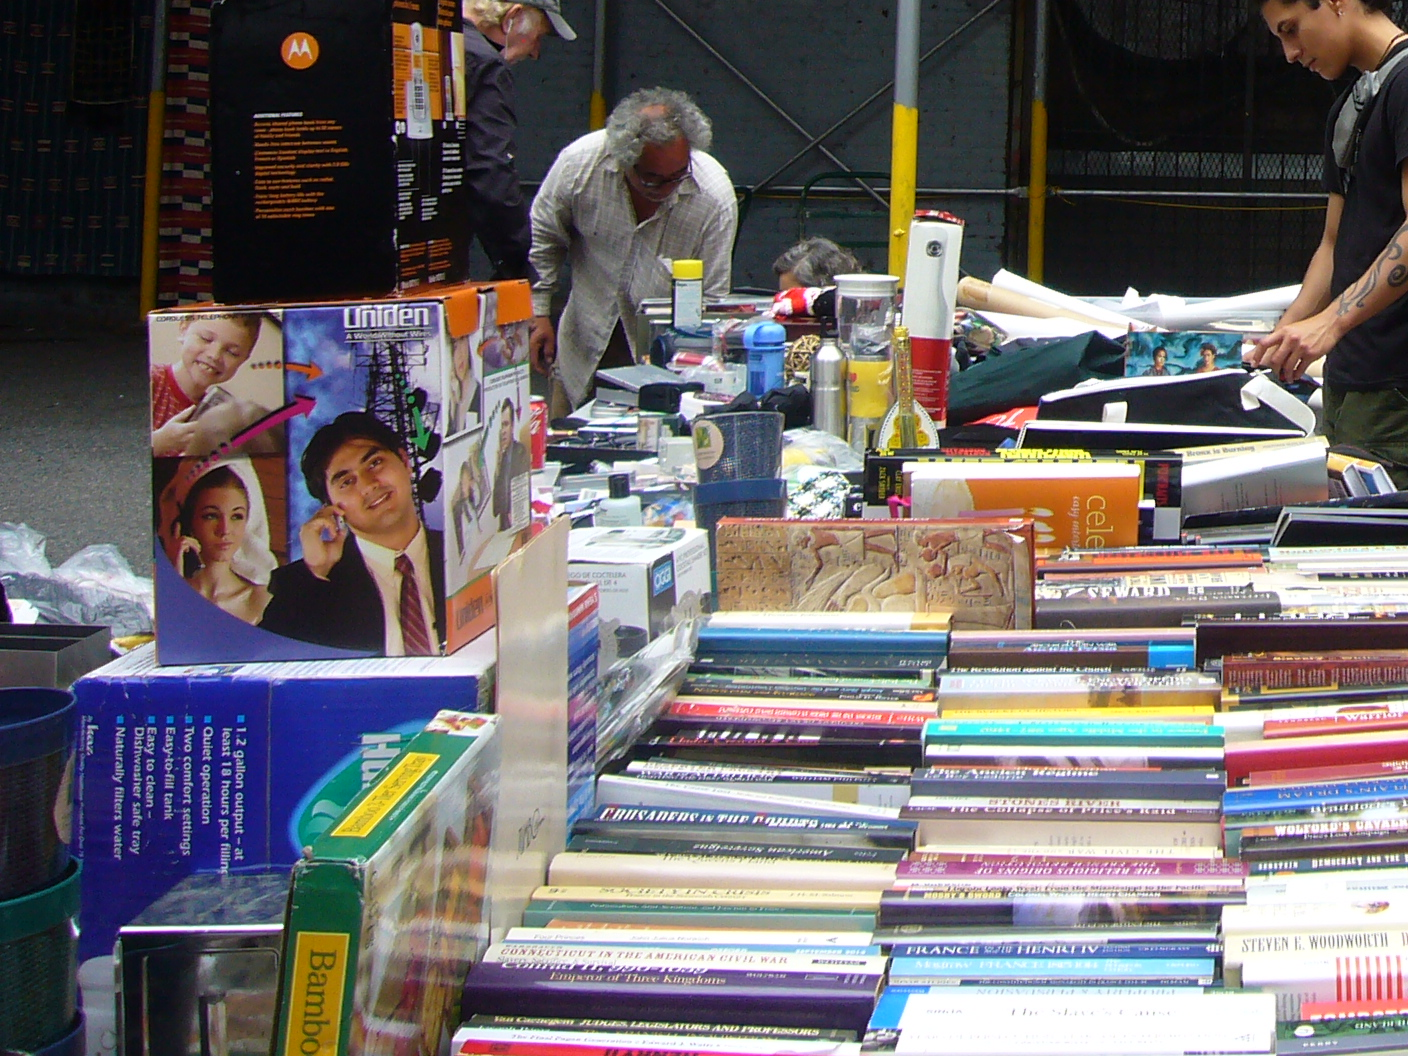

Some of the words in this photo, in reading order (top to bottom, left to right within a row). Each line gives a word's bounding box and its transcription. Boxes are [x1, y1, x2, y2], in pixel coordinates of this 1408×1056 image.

[344, 305, 429, 328] Uniden
[1222, 445, 1255, 455] Burning
[592, 571, 627, 579] COCTELERA
[654, 566, 672, 588] OGGI
[1087, 586, 1171, 599] SEWARD
[1345, 711, 1401, 723] Warrior
[144, 727, 157, 755] Easy
[184, 726, 195, 752] Two
[202, 726, 213, 761] Quiet
[221, 727, 233, 757] least
[236, 726, 247, 746] 1.2
[112, 727, 126, 783] Naturally
[133, 727, 145, 799] Dishwasher
[162, 727, 176, 789] Easy-to-fill
[146, 760, 156, 772] to
[221, 761, 232, 776] 18
[233, 751, 247, 789] gallon
[183, 756, 194, 804] comfort
[145, 776, 156, 808] clean
[200, 764, 213, 825] operation
[220, 780, 232, 816] hours
[988, 798, 1060, 806] STONES
[1278, 789, 1341, 799] DREAM
[114, 787, 125, 821] filters
[164, 793, 174, 820] tank
[232, 792, 246, 835] output
[984, 807, 1053, 815] Collapse
[132, 802, 143, 828] safe
[599, 807, 700, 823] CRUSADERS
[700, 814, 715, 823] IN
[718, 814, 750, 824] THE
[180, 808, 193, 856] settings
[217, 819, 231, 841] per
[1274, 821, 1350, 837] WOLFORD'S
[113, 824, 123, 860] water
[130, 830, 141, 855] tray
[234, 847, 245, 861] at
[974, 866, 993, 875] OF
[997, 867, 1054, 875] ORIGINS
[1057, 867, 1130, 875] RELIGIOUS
[1134, 867, 1160, 875] THE
[1258, 861, 1299, 870] SUNSTEIN
[906, 945, 980, 955] FRANCE
[1017, 945, 1077, 955] HENRI
[1080, 945, 1099, 954] IV
[1241, 935, 1290, 953] STEVEN
[1294, 935, 1305, 951] E.
[1308, 932, 1390, 950] WOODWORTH
[500, 948, 596, 957] CONNECTICUT
[617, 951, 645, 959] THE
[647, 952, 716, 962] AMERICAN
[719, 954, 756, 963] CIVIL
[759, 956, 789, 965] WAR
[501, 962, 575, 971] Conrad
[979, 961, 1044, 969] FRANCE
[549, 971, 605, 983] Emperor
[607, 972, 623, 983] of
[625, 973, 660, 983] Three
[662, 975, 727, 986] Kingdoms
[299, 948, 338, 1056] Bambo
[493, 1015, 513, 1023] Van
[579, 1019, 628, 1028] JUDGES,
[629, 1021, 710, 1032] LEGISLATORS
[713, 1024, 739, 1033] AND
[741, 1026, 820, 1036] PROFESSORS
